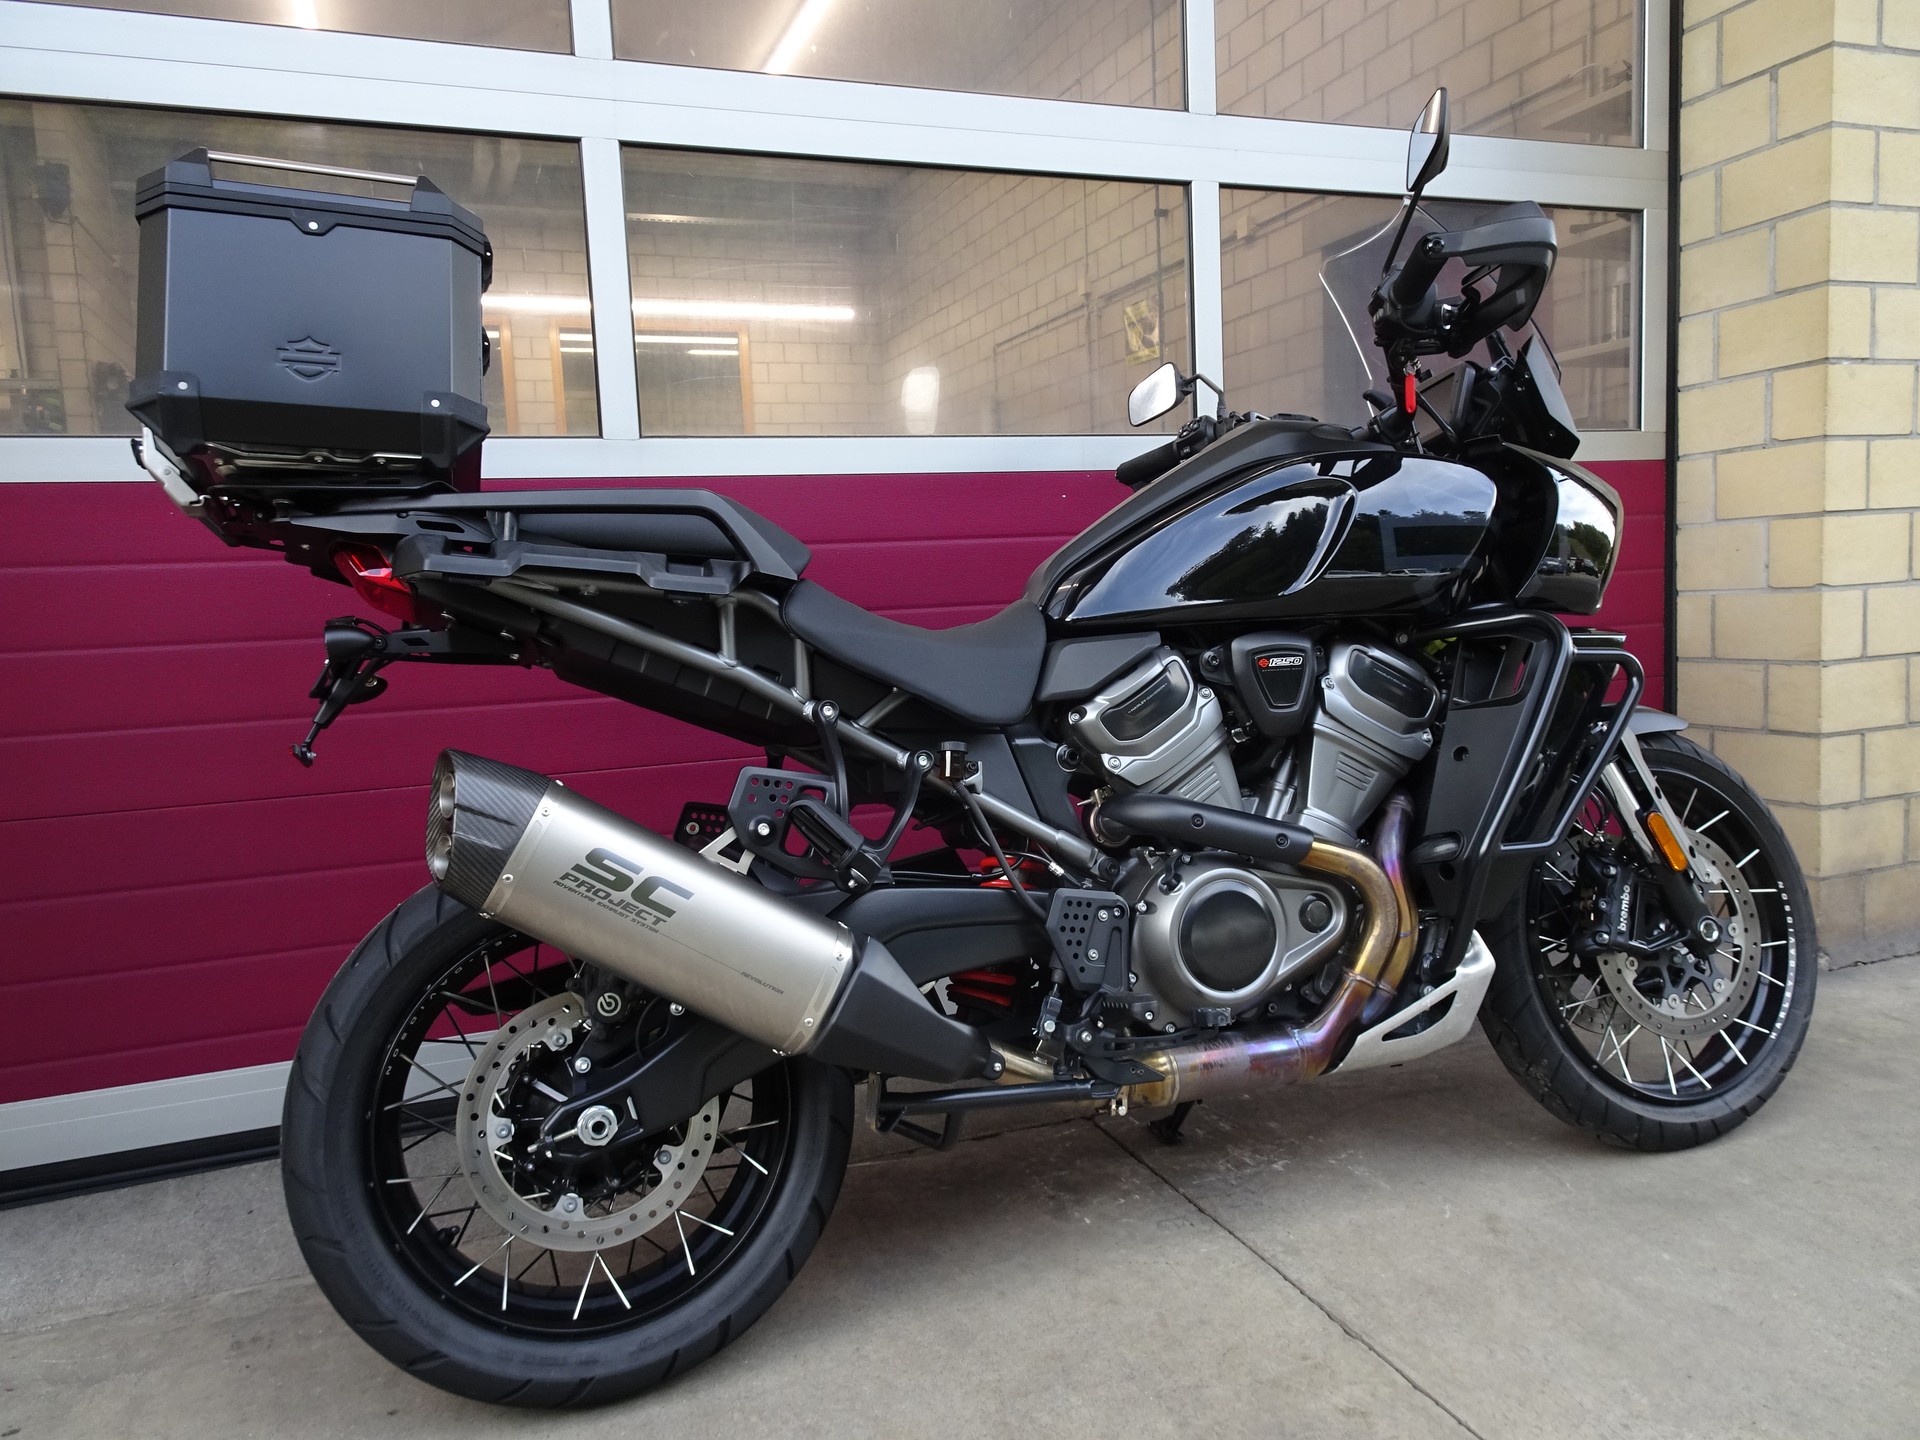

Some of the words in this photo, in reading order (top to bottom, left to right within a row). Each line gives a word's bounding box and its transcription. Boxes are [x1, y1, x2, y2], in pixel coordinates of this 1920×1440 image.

[1269, 656, 1303, 667] 1250
[553, 880, 596, 904] ADVENTURE
[596, 900, 630, 919] EXHAUST
[630, 917, 660, 934] SYSTEM
[559, 872, 667, 926] PROJECT
[570, 847, 695, 918] SC
[1617, 884, 1631, 932] brembo
[740, 971, 785, 995] REVOLUTION
[1769, 880, 1797, 1040] HARLEY-DAVIDSON
